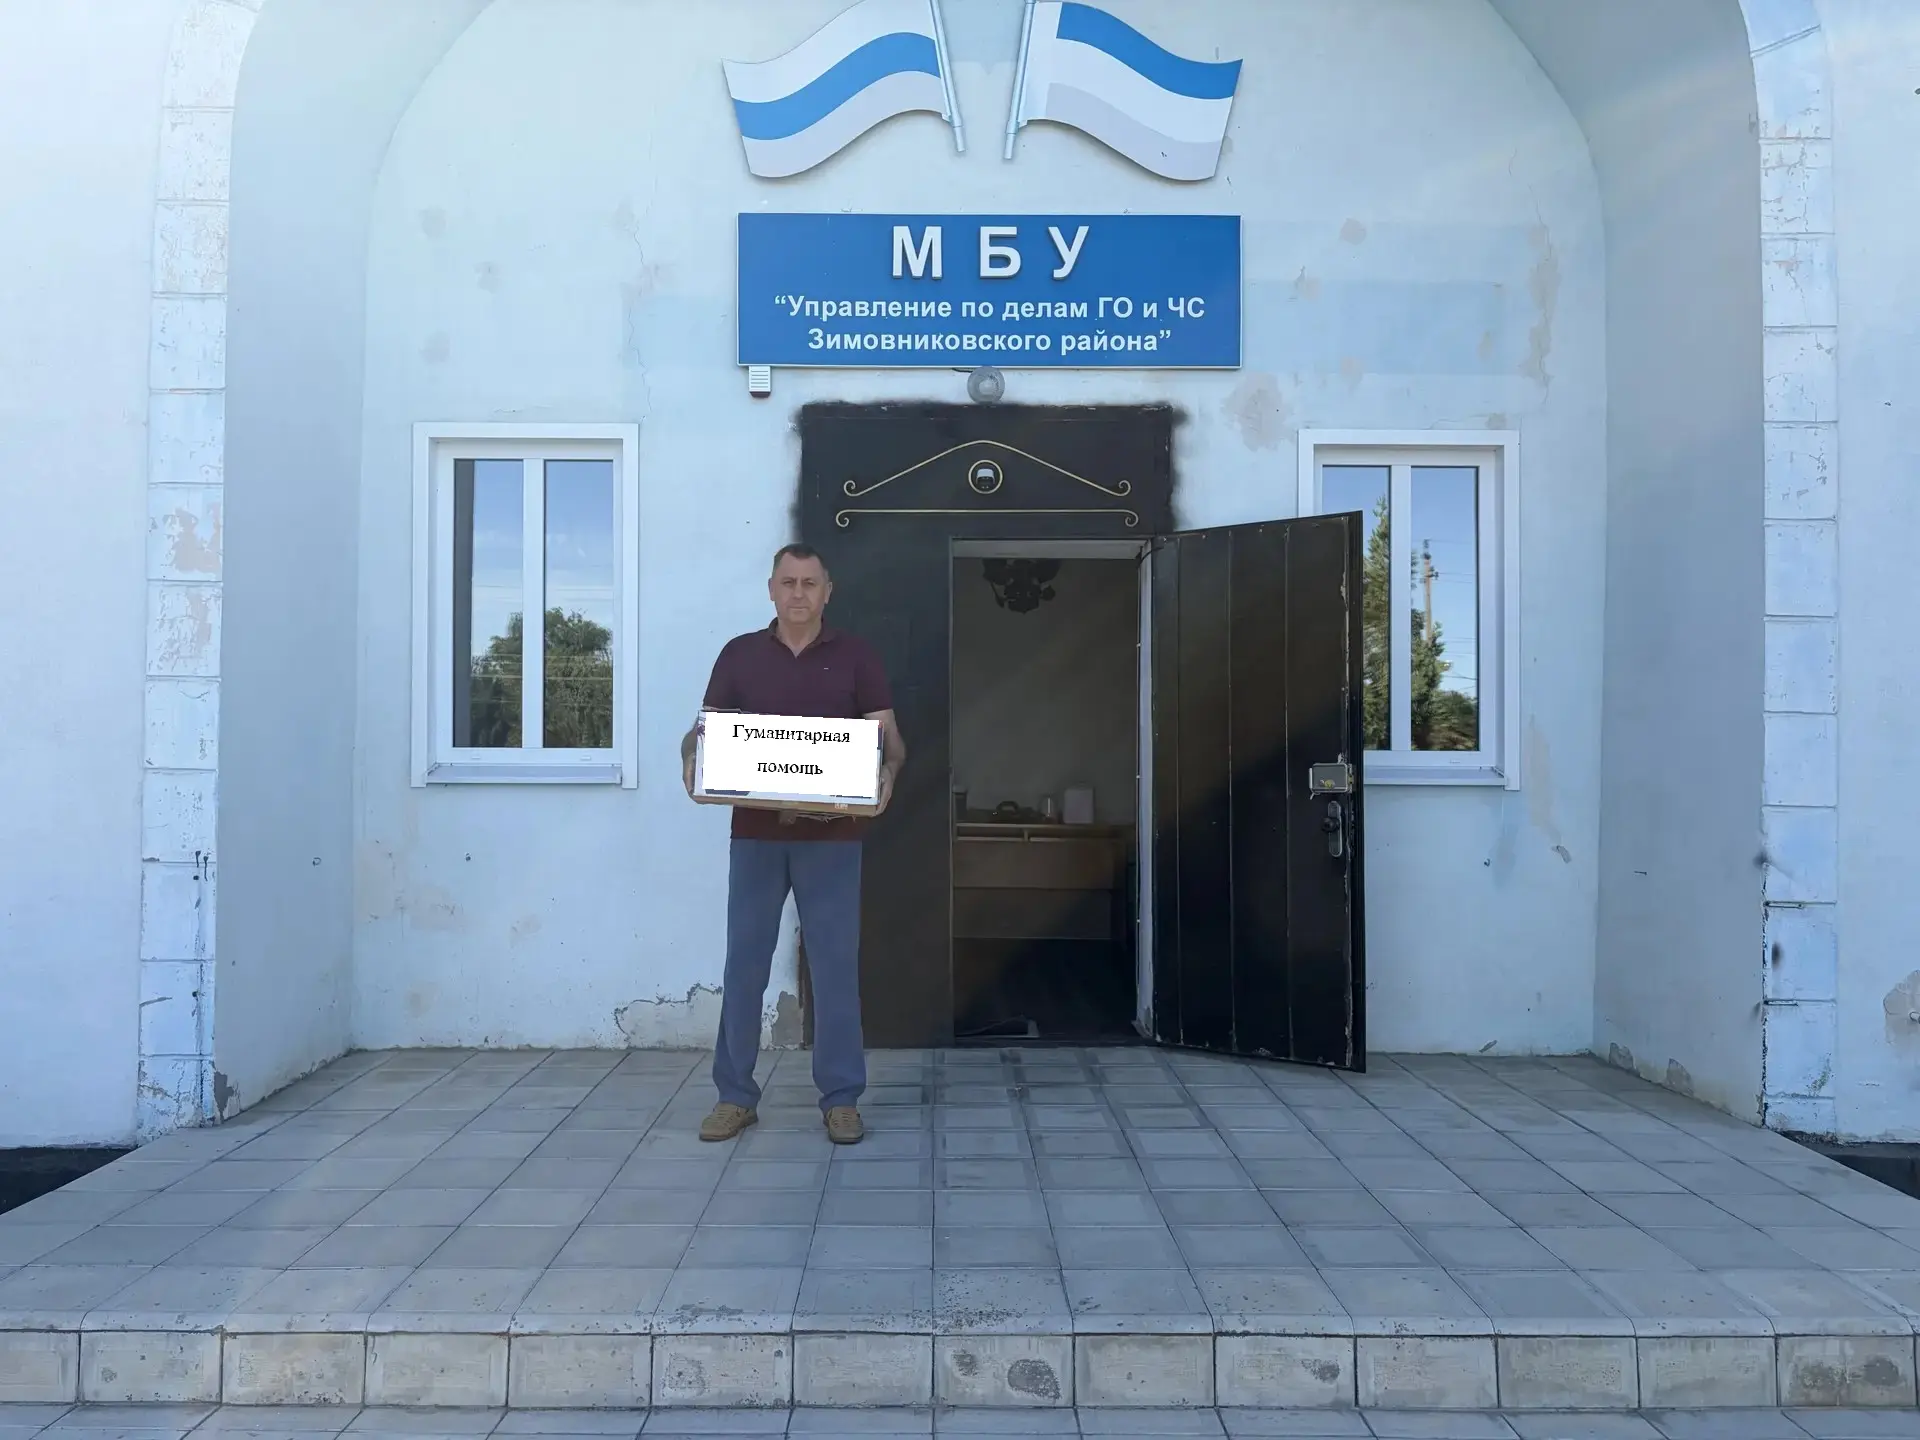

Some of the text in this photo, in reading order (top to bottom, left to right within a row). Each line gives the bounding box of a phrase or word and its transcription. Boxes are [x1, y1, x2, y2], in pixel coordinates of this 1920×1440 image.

[961, 301, 994, 318] по
[1002, 302, 1088, 321] делам
[1098, 297, 1133, 318] ГО
[1143, 302, 1158, 318] и
[1168, 297, 1205, 318] ЧС
[808, 328, 1051, 352] Зимовниковского
